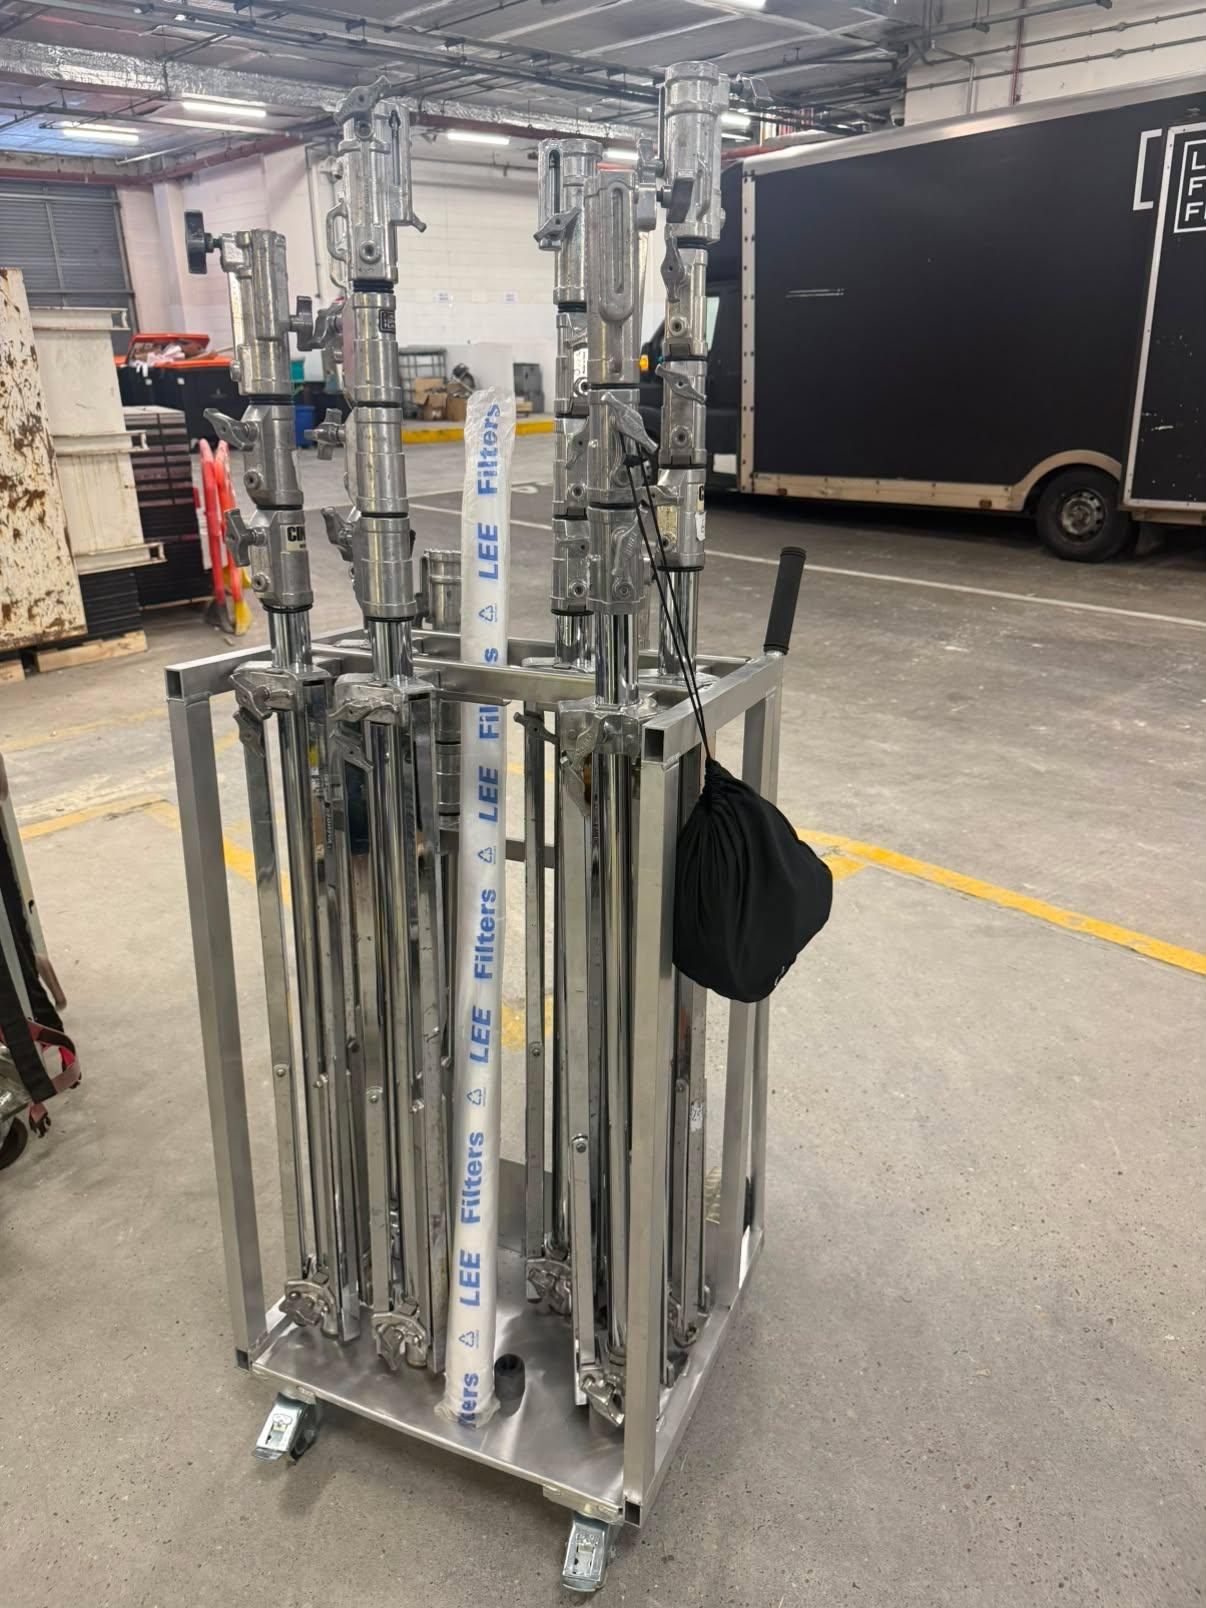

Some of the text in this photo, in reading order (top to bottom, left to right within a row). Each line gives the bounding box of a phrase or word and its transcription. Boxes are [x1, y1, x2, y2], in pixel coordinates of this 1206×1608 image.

[477, 403, 500, 581] LEE Filters
[478, 766, 499, 824] LEE
[469, 888, 497, 1064] LEE Filters
[458, 1131, 485, 1307] LEE Filters
